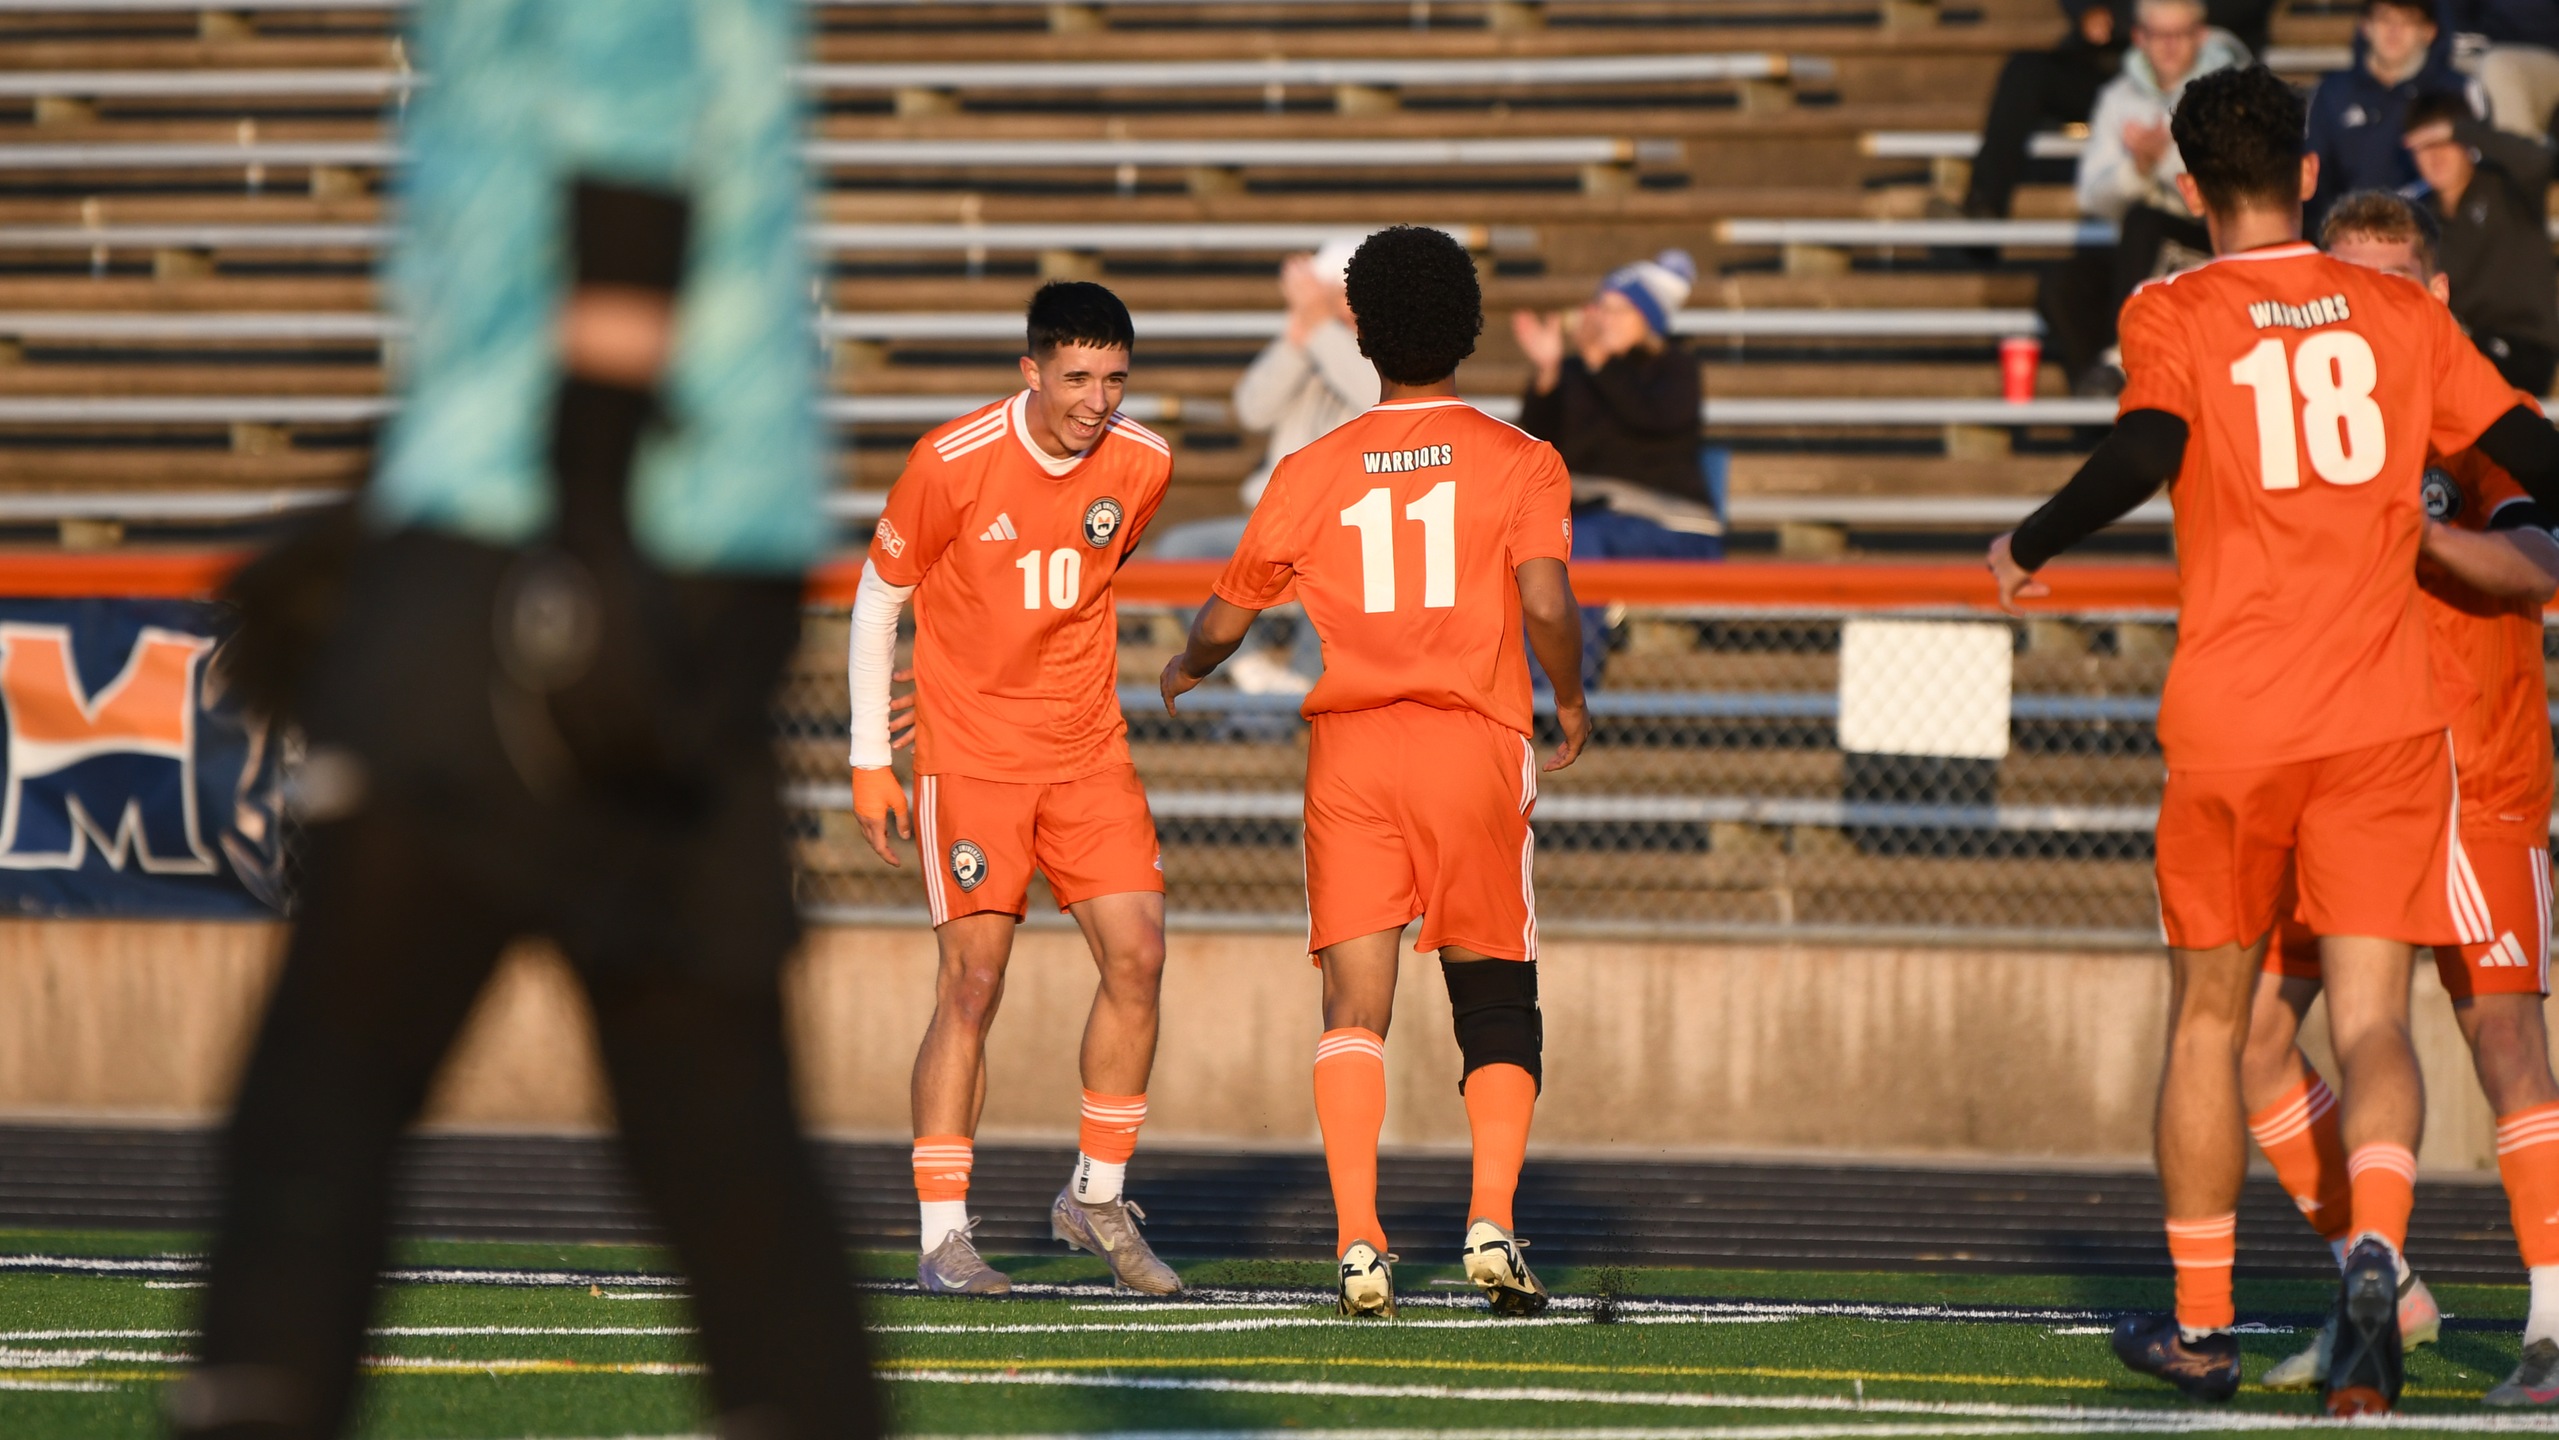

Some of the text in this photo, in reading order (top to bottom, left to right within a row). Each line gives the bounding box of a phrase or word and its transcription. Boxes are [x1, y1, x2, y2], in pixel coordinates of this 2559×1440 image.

[2230, 329, 2387, 490] 18
[1363, 444, 1453, 474] WARRIORS
[1016, 547, 1081, 610] 10
[1340, 481, 1456, 614] 11
